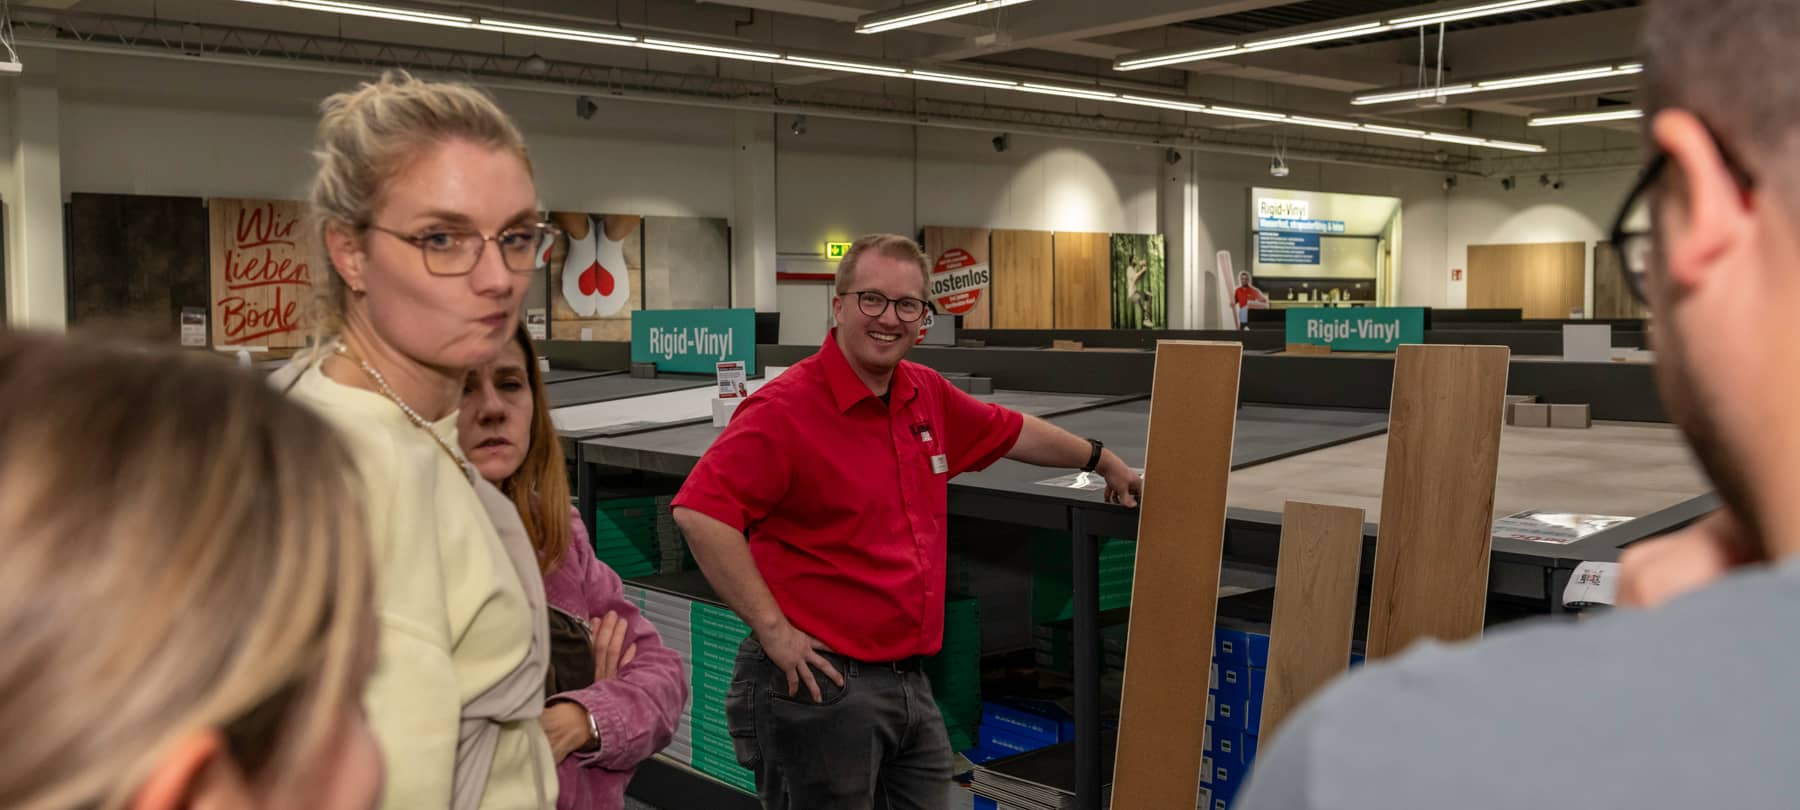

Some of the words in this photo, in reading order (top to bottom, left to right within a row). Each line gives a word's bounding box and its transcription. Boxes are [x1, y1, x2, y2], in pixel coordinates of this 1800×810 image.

[236, 203, 299, 242] Wir
[1261, 201, 1306, 219] Rigid-Vinyl
[224, 249, 311, 283] lieben
[930, 268, 989, 296] ostenlos
[217, 287, 300, 337] Böde
[649, 327, 733, 361] Rigid-Vinyl
[1307, 319, 1400, 343] Rigid-Vinyl
